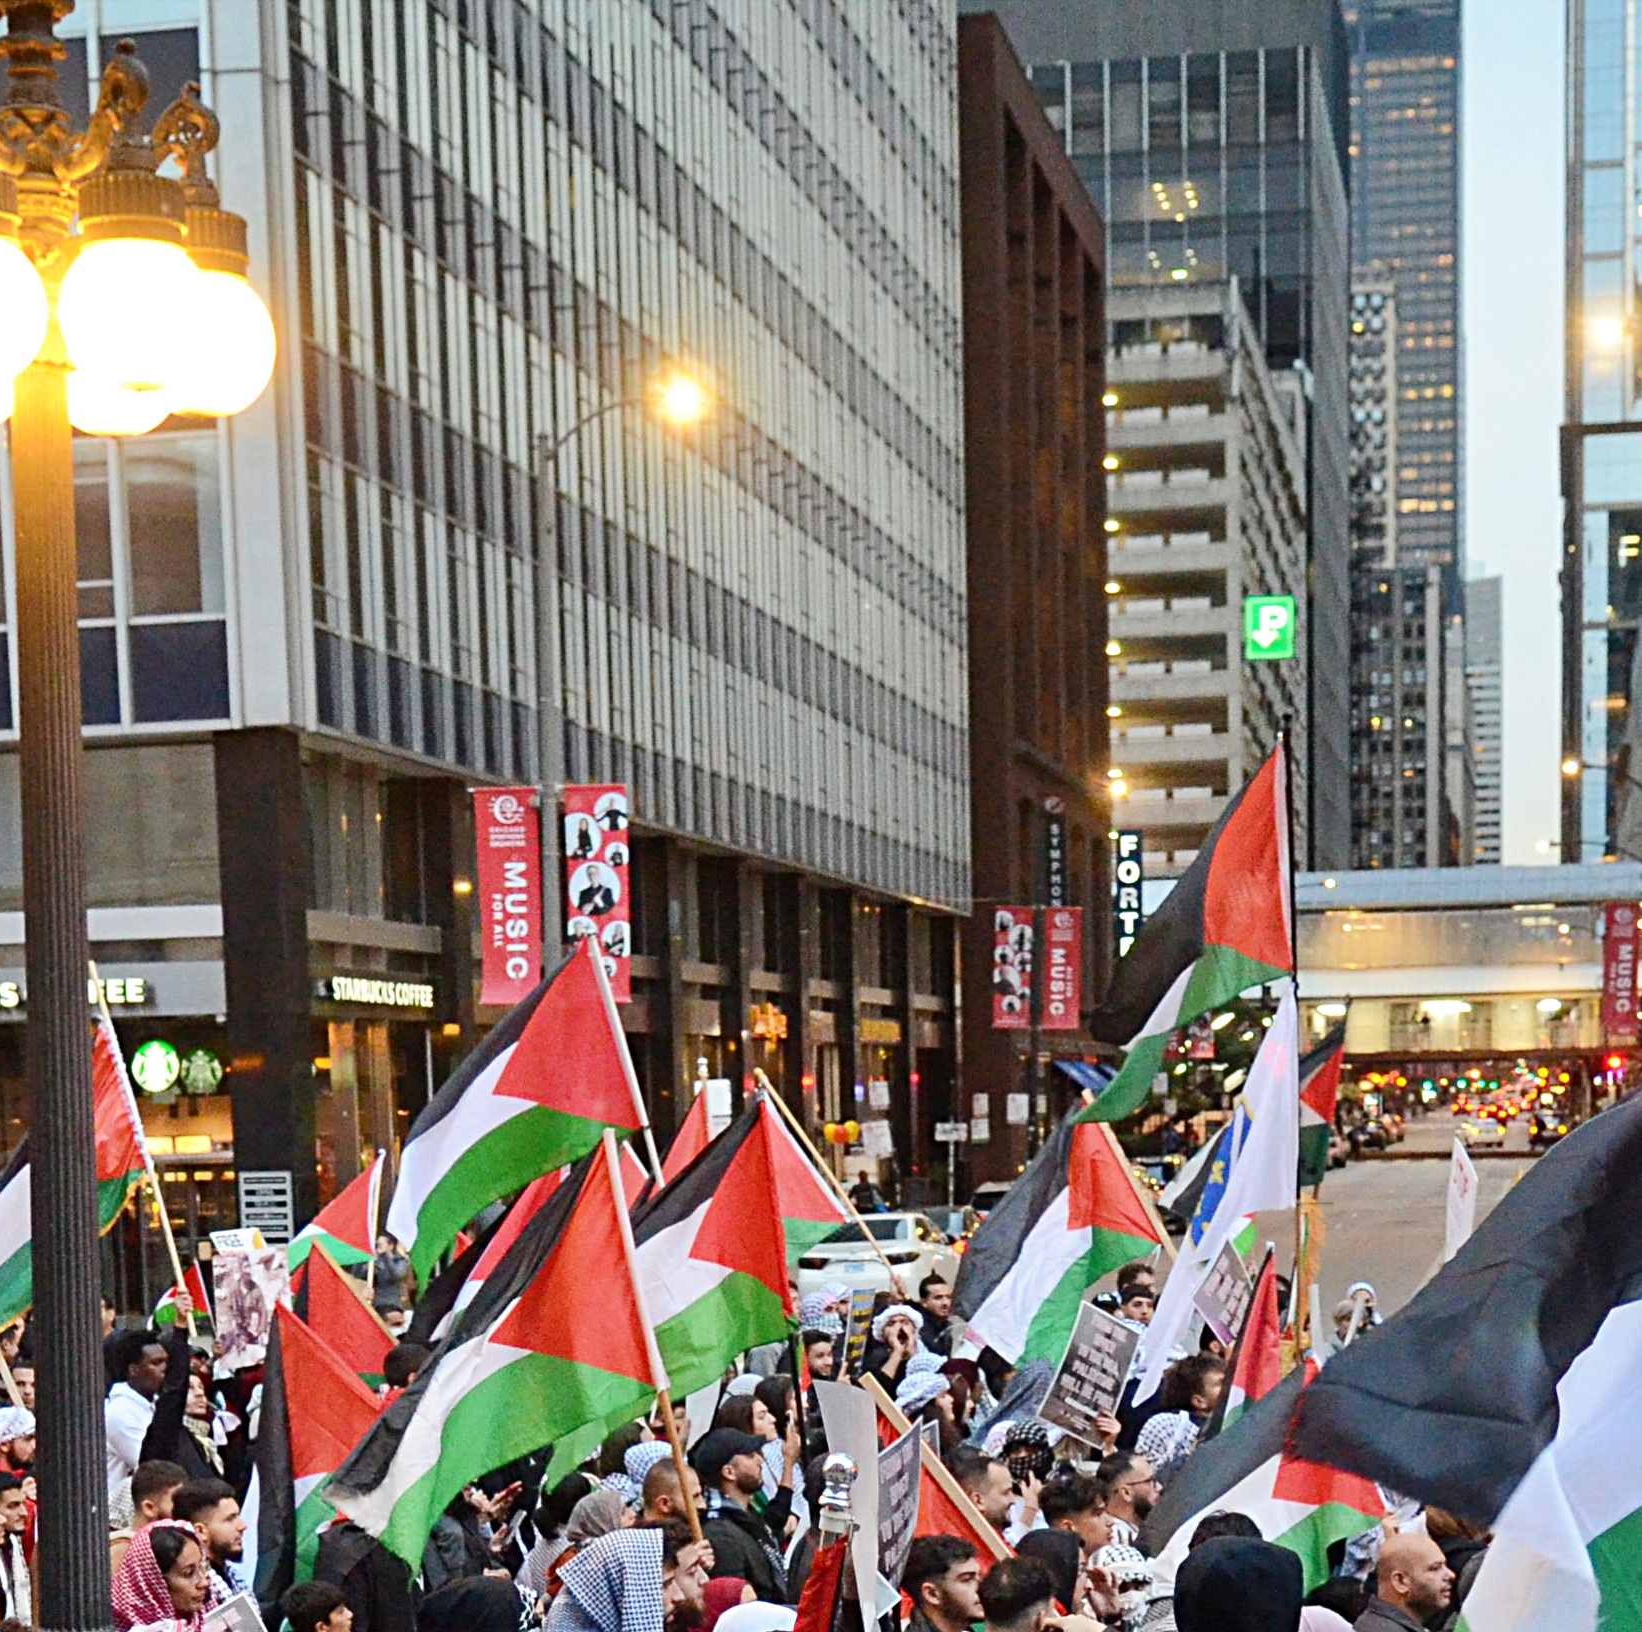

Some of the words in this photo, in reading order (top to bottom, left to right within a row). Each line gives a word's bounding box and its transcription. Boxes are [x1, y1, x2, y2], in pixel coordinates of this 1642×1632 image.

[1050, 823, 1062, 907] SYMPHON
[492, 893, 504, 920] FOR
[504, 861, 529, 980] MUSIC
[494, 925, 504, 947] ALL
[88, 977, 145, 1004] FEE
[332, 976, 395, 1005] STARBUCKS
[396, 982, 434, 1008] COFFEE
[1049, 948, 1066, 1016] MUSIC
[1615, 943, 1634, 1014] MUSIC
